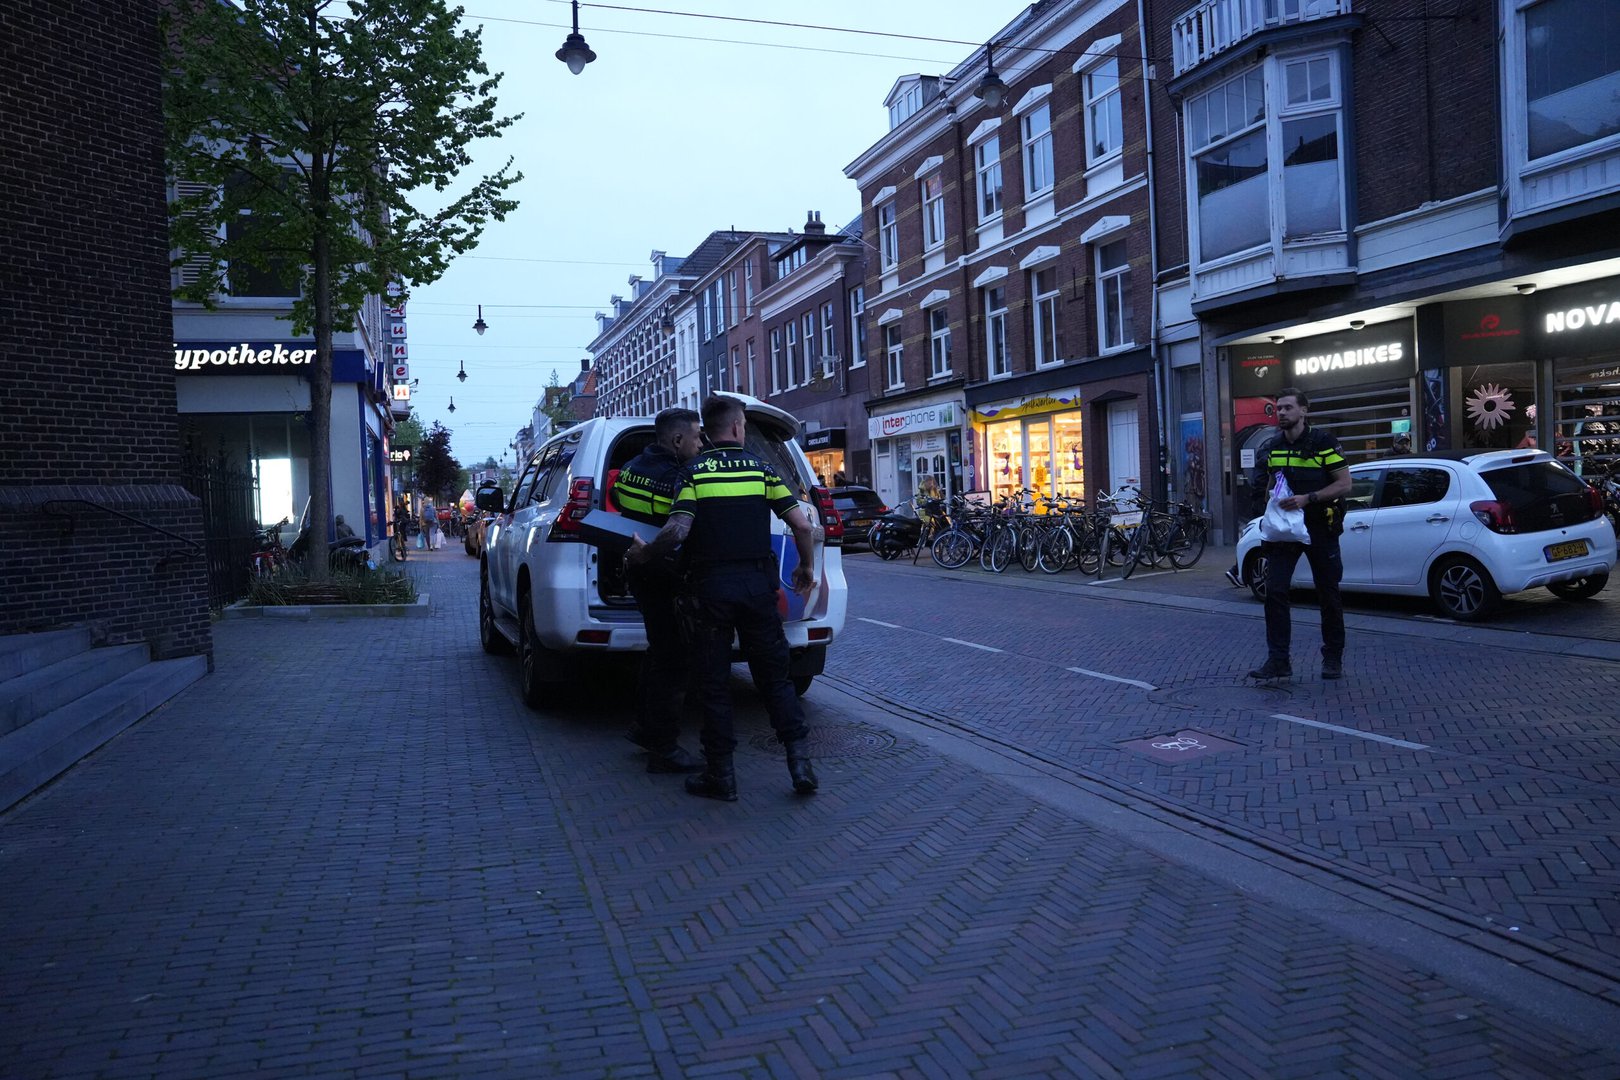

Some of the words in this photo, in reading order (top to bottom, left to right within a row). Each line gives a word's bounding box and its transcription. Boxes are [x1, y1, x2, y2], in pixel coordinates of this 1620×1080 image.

[172, 343, 316, 370] ypotheker
[1294, 342, 1403, 376] NOVABIKES
[882, 410, 936, 431] interphone
[697, 457, 756, 472] POLITIE
